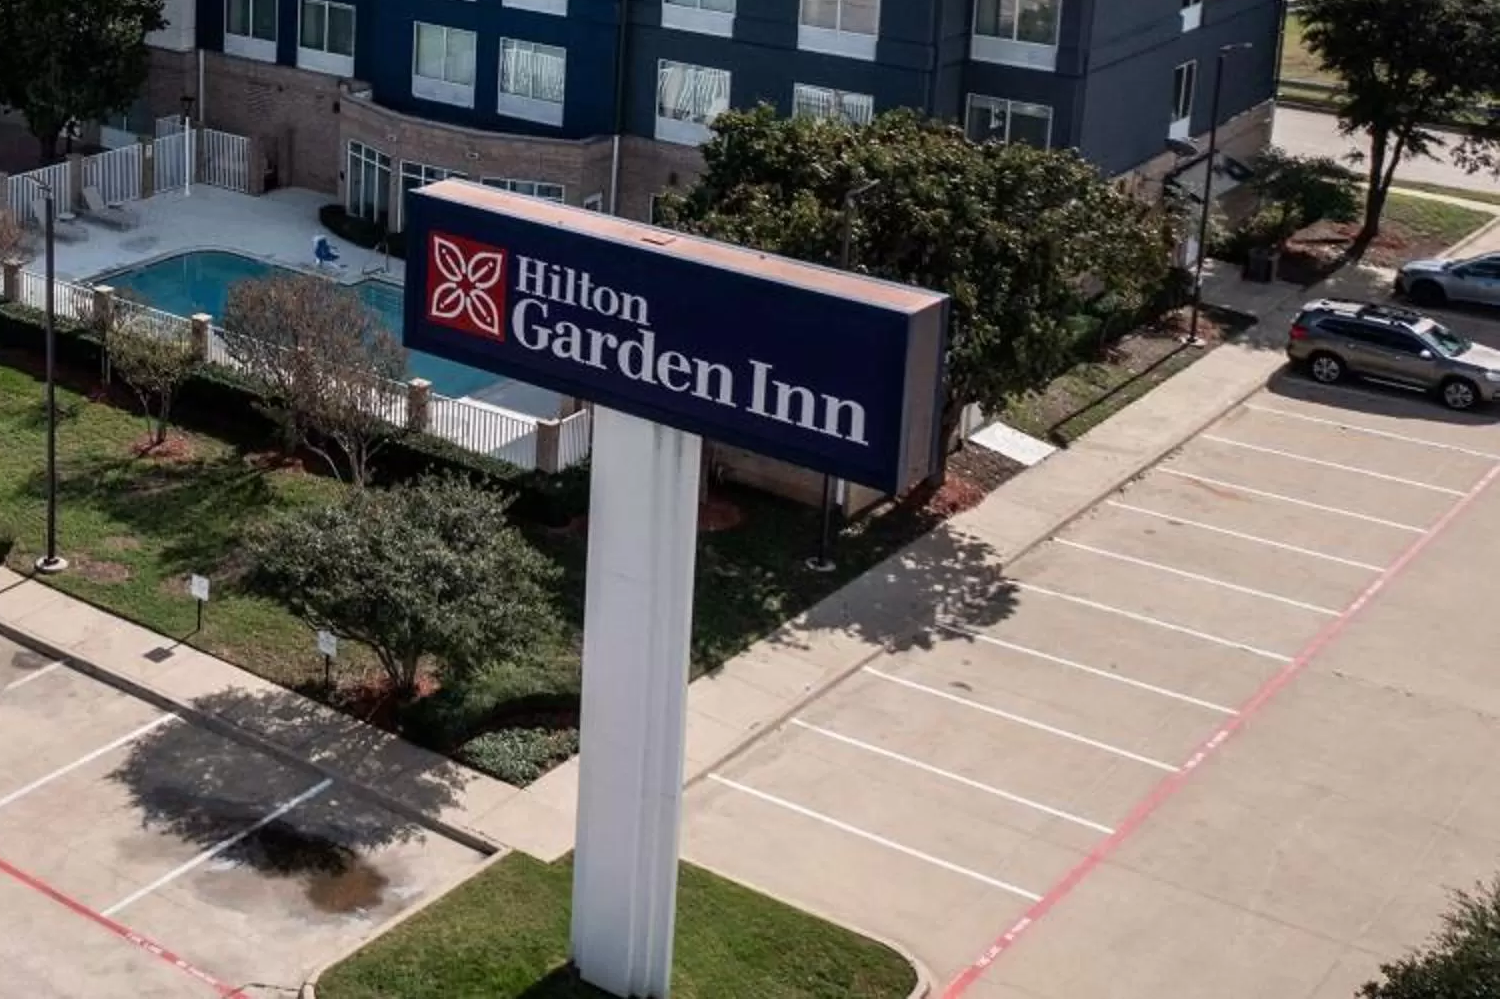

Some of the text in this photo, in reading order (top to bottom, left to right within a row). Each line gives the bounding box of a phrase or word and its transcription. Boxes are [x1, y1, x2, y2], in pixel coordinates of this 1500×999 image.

[515, 254, 651, 326] Hilton
[511, 298, 869, 446] Garden Inn
